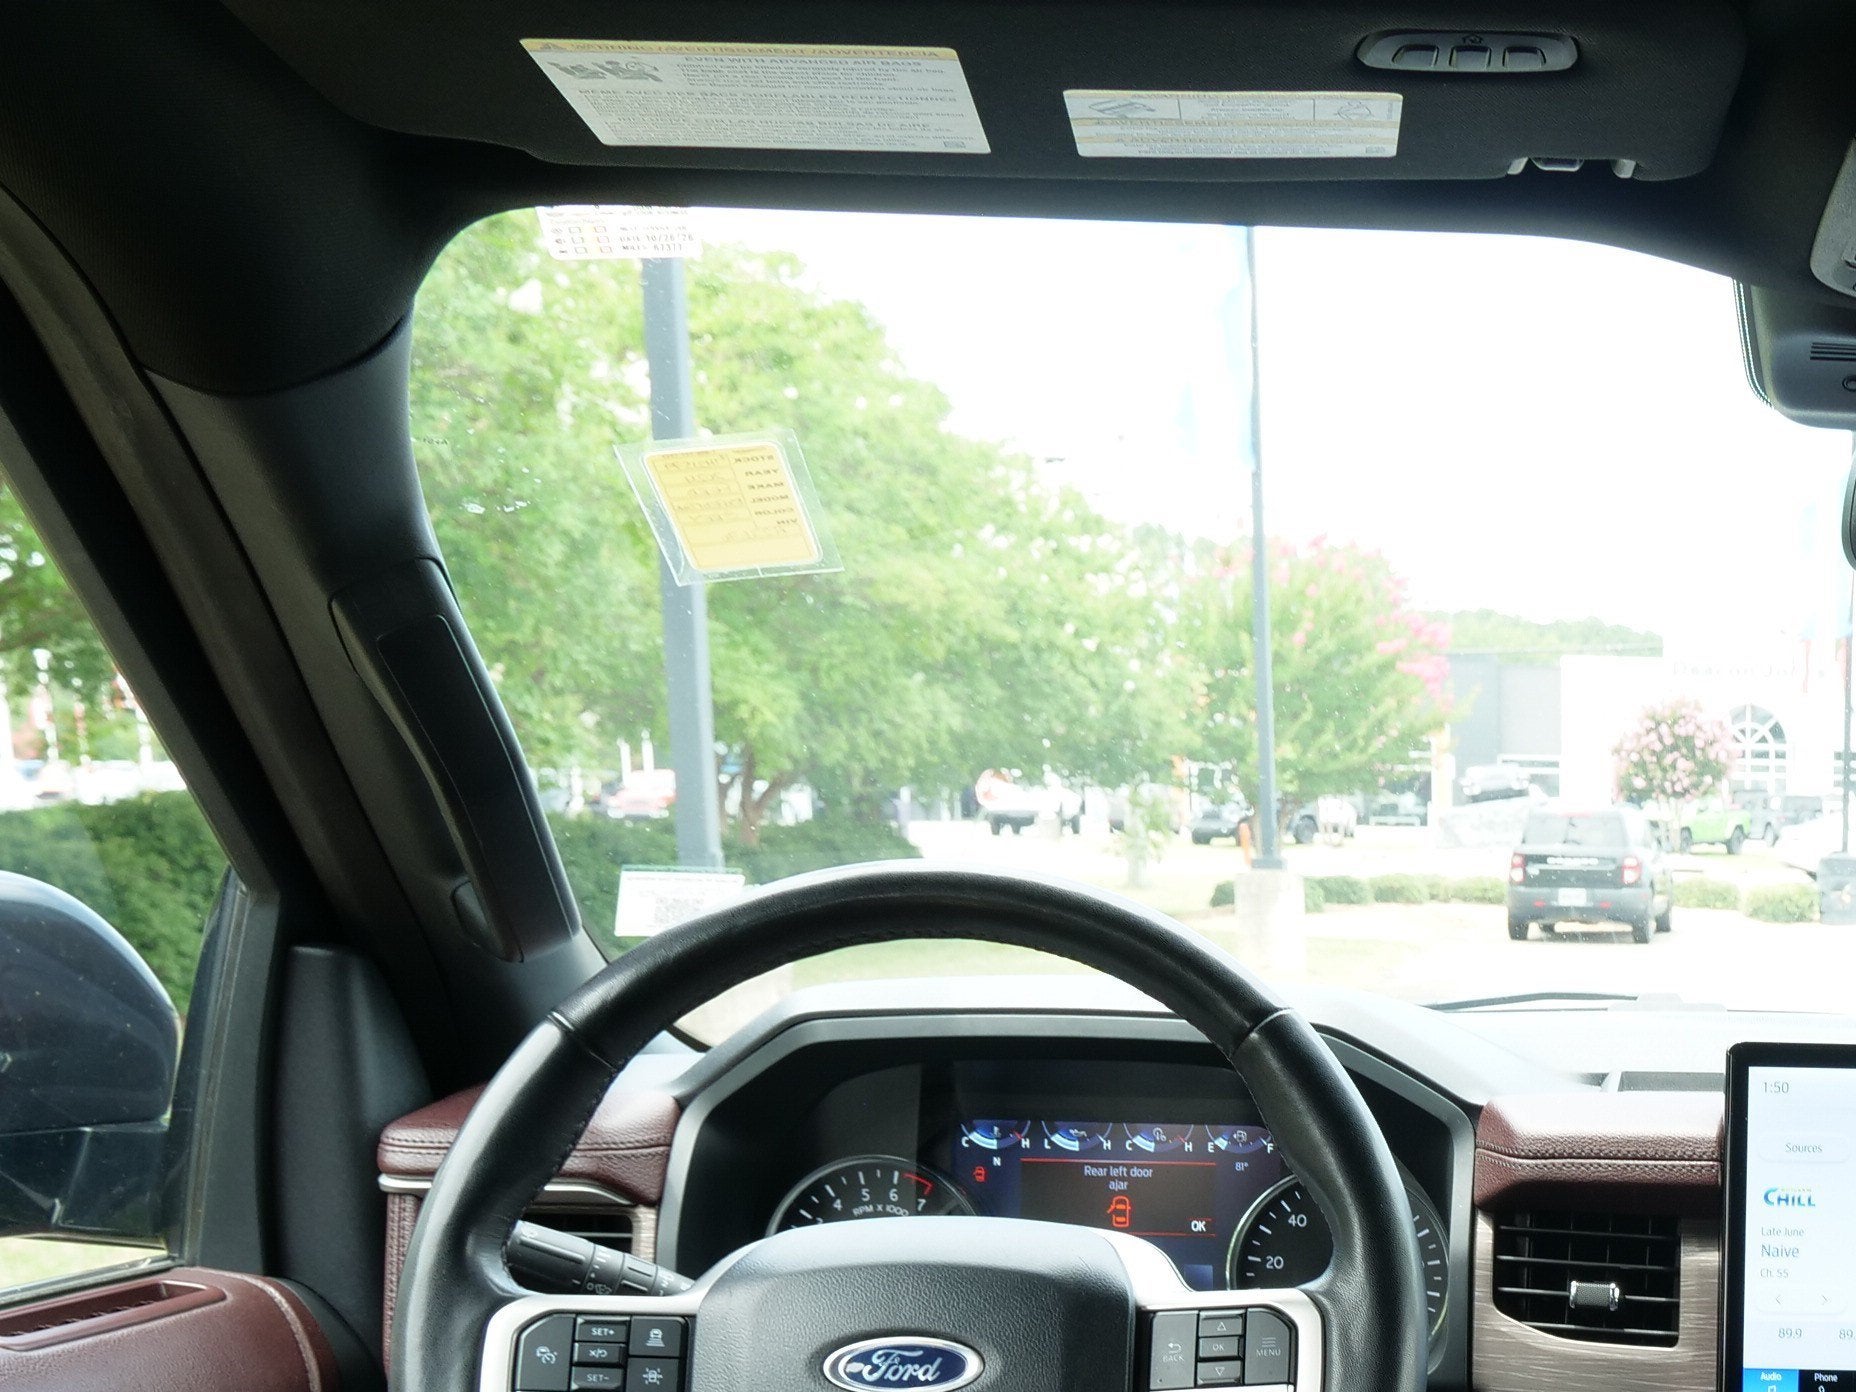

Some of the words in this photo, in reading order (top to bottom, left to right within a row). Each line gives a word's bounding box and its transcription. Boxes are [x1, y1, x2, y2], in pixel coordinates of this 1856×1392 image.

[1763, 1081, 1789, 1094] 1:50
[961, 1137, 970, 1149] C
[1021, 1138, 1031, 1149] H
[1043, 1138, 1051, 1150] L
[1103, 1139, 1112, 1151] H
[1125, 1140, 1133, 1152] C
[1184, 1141, 1193, 1153] H
[1207, 1142, 1215, 1153] E
[1266, 1142, 1274, 1154] F
[1785, 1142, 1823, 1154] Sources
[992, 1156, 1002, 1167] N
[1084, 1165, 1107, 1177] Rear
[1109, 1165, 1128, 1178] left
[1130, 1166, 1153, 1178] door
[1108, 1179, 1129, 1191] ajar
[861, 1188, 871, 1202] 5
[888, 1188, 899, 1202] 6
[832, 1199, 843, 1212] 4
[852, 1204, 874, 1217] RPM
[885, 1203, 910, 1217] 1000
[917, 1198, 927, 1212] 7
[1190, 1220, 1207, 1232] OK
[1288, 1213, 1307, 1228] 40
[1761, 1226, 1782, 1237] Late
[1784, 1226, 1805, 1237] June
[1761, 1243, 1800, 1258] Naive
[1265, 1255, 1284, 1270] 20
[1777, 1327, 1803, 1339] 89.9
[1212, 1342, 1225, 1352] OK
[1256, 1347, 1281, 1357] MENU
[1162, 1354, 1185, 1363] BACK
[862, 1349, 943, 1383] Ford
[1760, 1372, 1782, 1382] Audio
[1814, 1373, 1838, 1383] Phone
